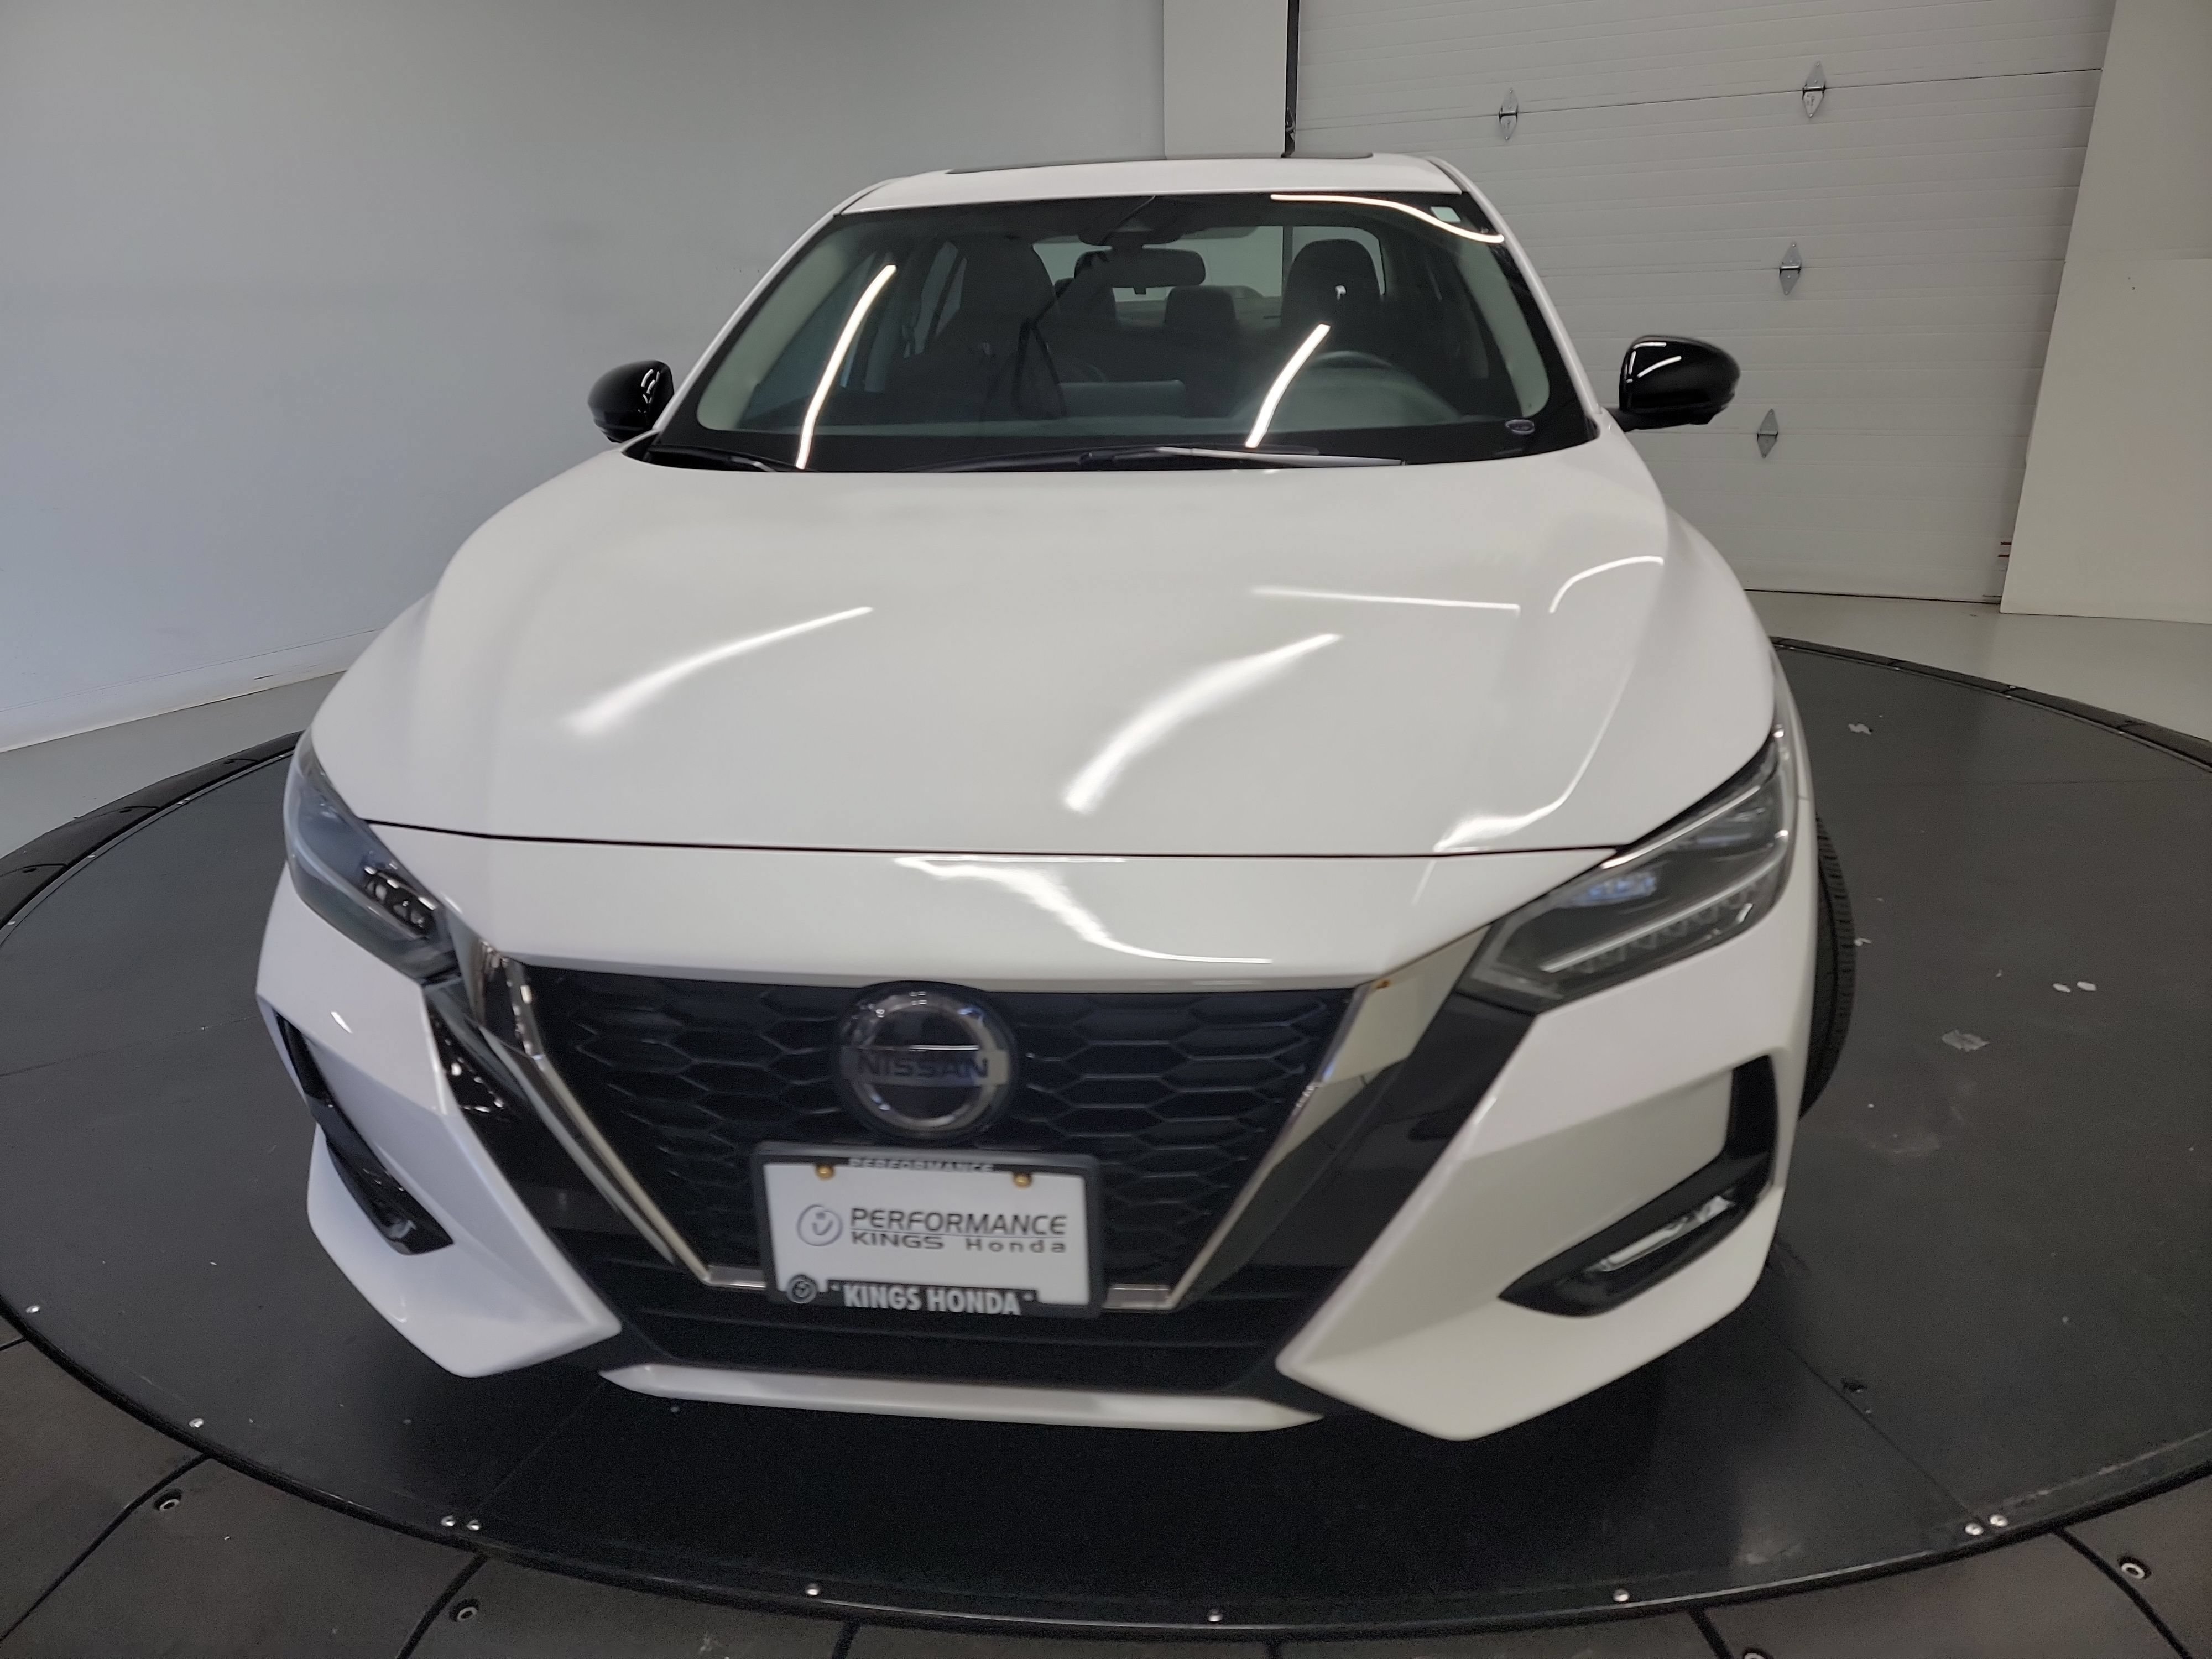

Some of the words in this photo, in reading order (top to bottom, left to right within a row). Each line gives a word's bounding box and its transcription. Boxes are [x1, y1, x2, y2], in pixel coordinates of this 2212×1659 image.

[857, 1055, 989, 1078] NISSAN
[850, 1207, 1068, 1236] PERFORMANCE
[851, 1230, 943, 1250] KINGS
[966, 1237, 1066, 1253] Honda
[842, 1284, 922, 1311] KINGS
[926, 1287, 1022, 1316] HONDA
